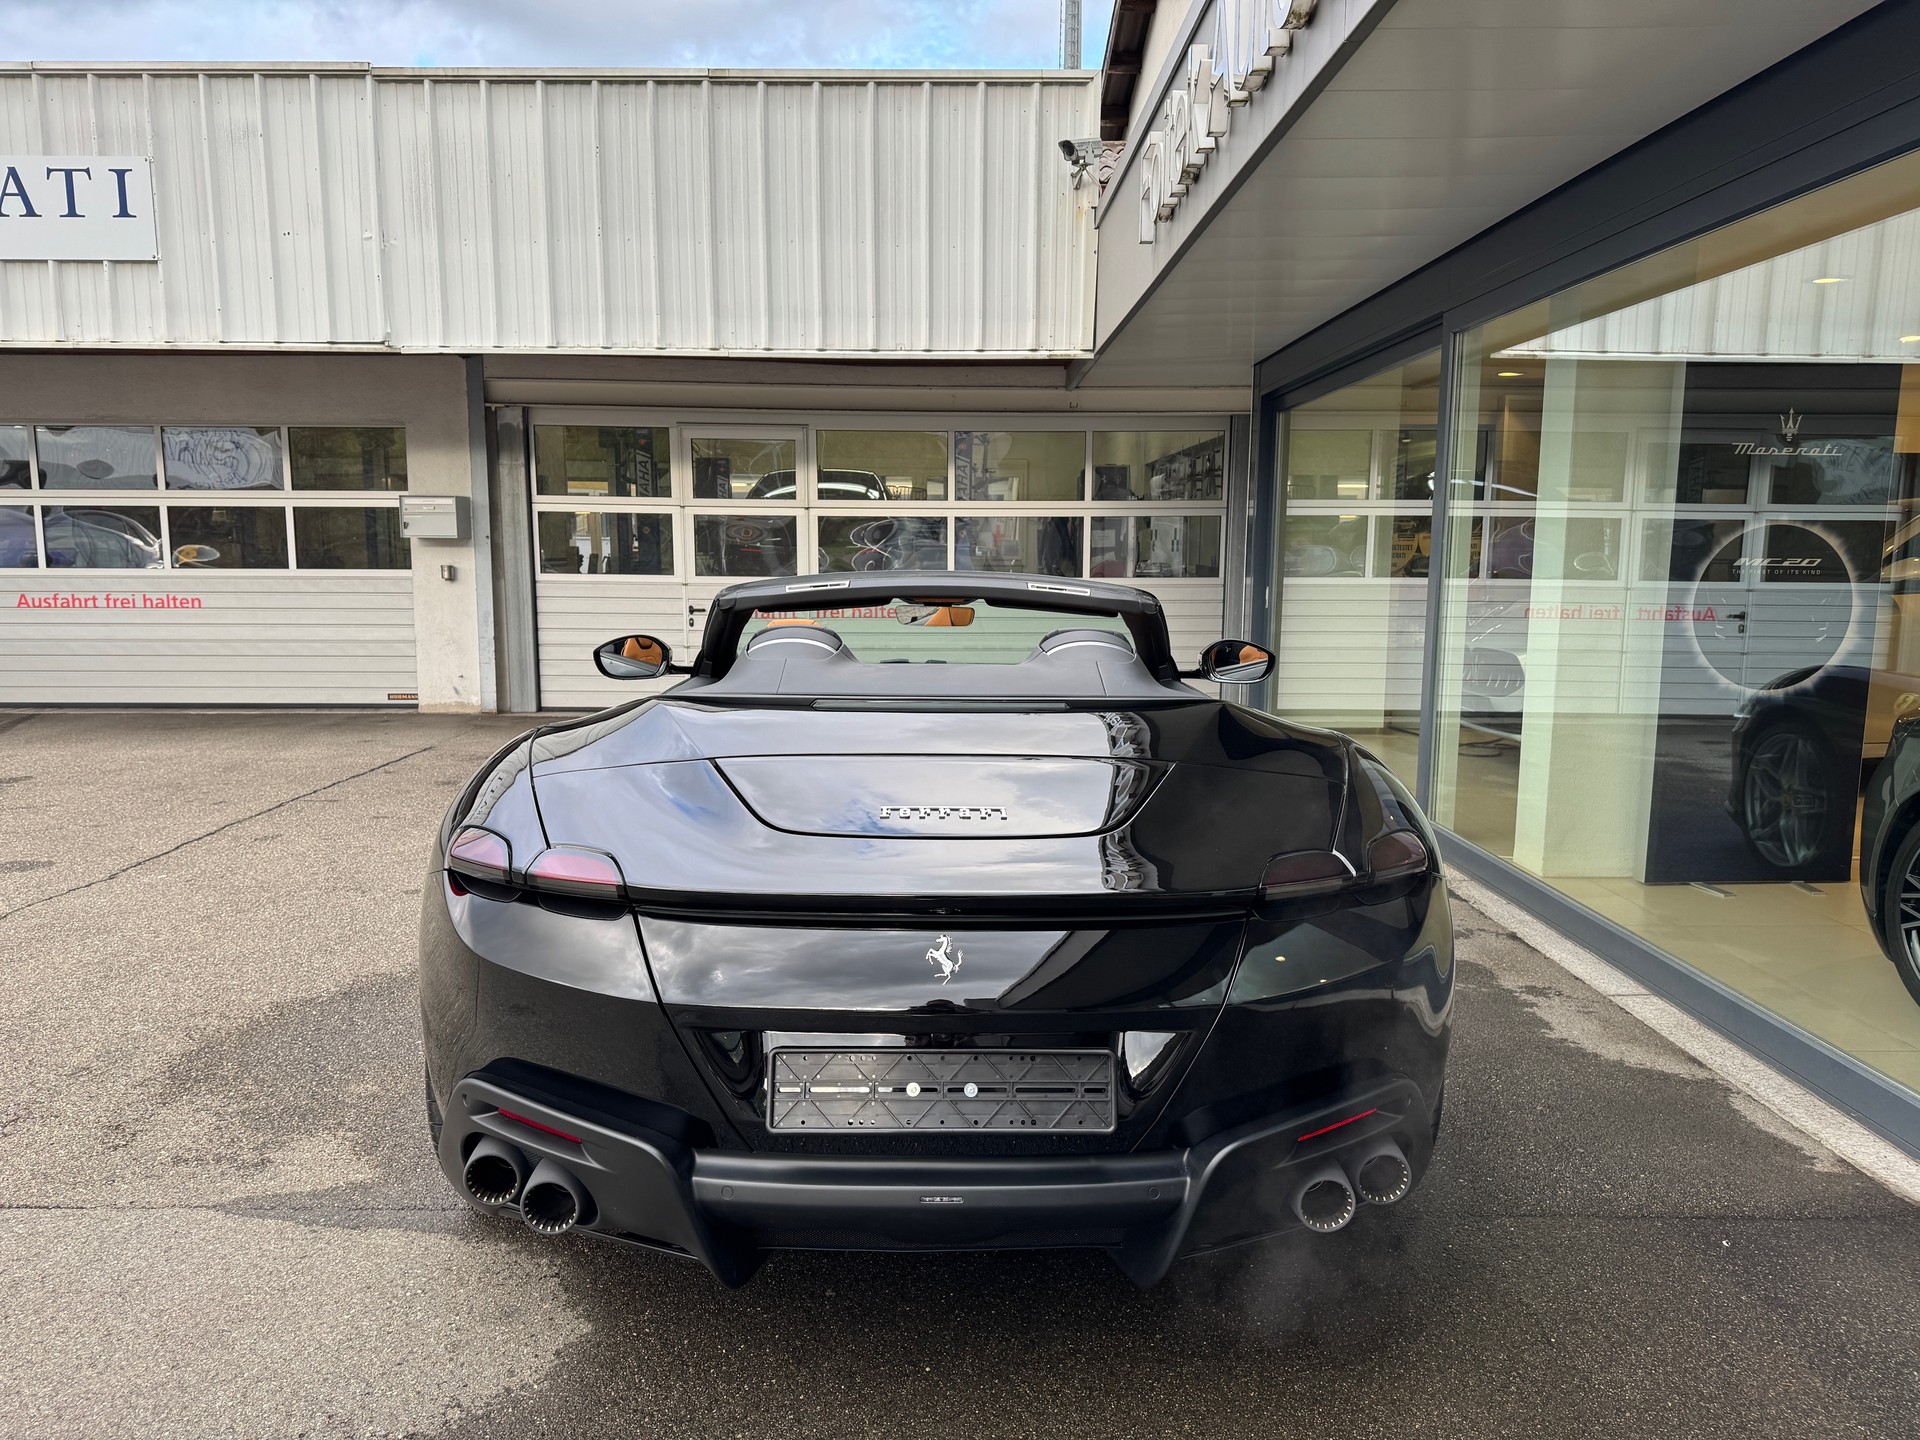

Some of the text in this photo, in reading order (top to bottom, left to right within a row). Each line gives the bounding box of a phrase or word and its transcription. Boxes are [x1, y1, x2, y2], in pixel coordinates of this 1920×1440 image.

[0, 166, 138, 218] ATI
[1732, 442, 1843, 456] Maserati
[16, 593, 202, 608] Ausfahrt frei halten
[880, 805, 1008, 820] Ferrari
